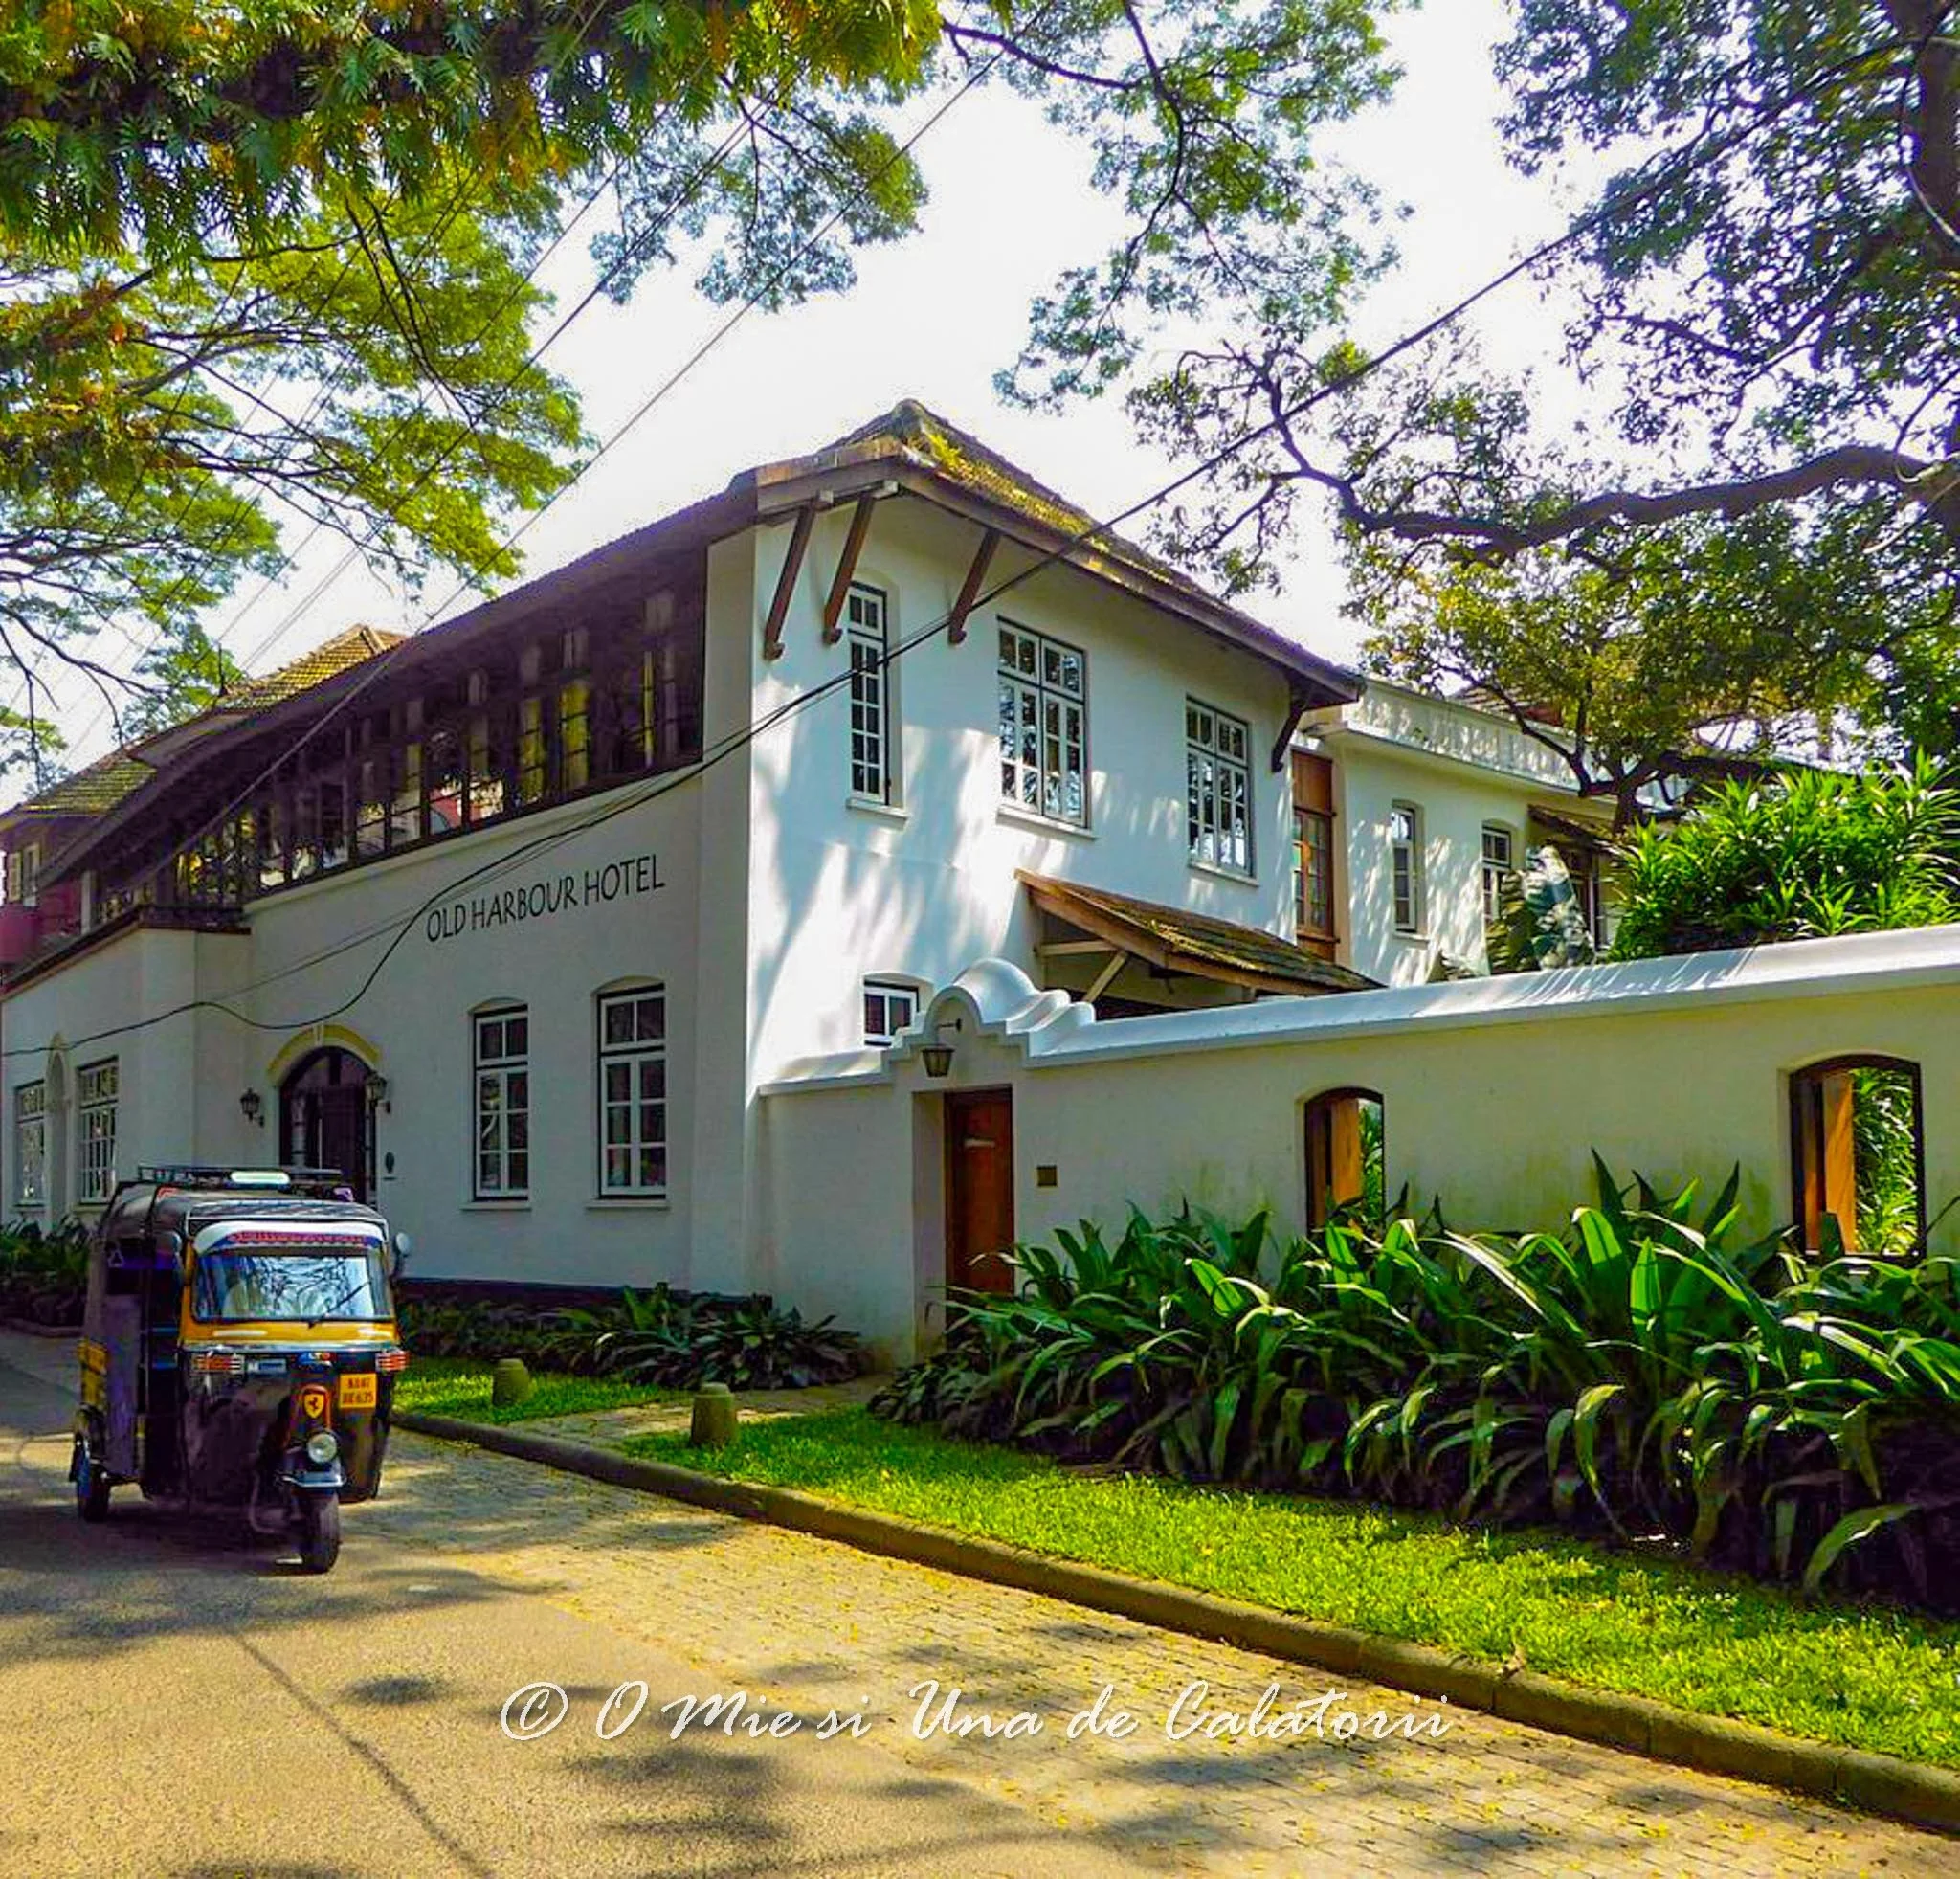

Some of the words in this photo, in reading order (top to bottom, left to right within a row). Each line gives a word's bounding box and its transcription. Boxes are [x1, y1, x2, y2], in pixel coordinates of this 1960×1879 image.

[426, 904, 467, 943] OLD
[471, 875, 578, 931] HARBOUR
[583, 853, 666, 906] HOTEL
